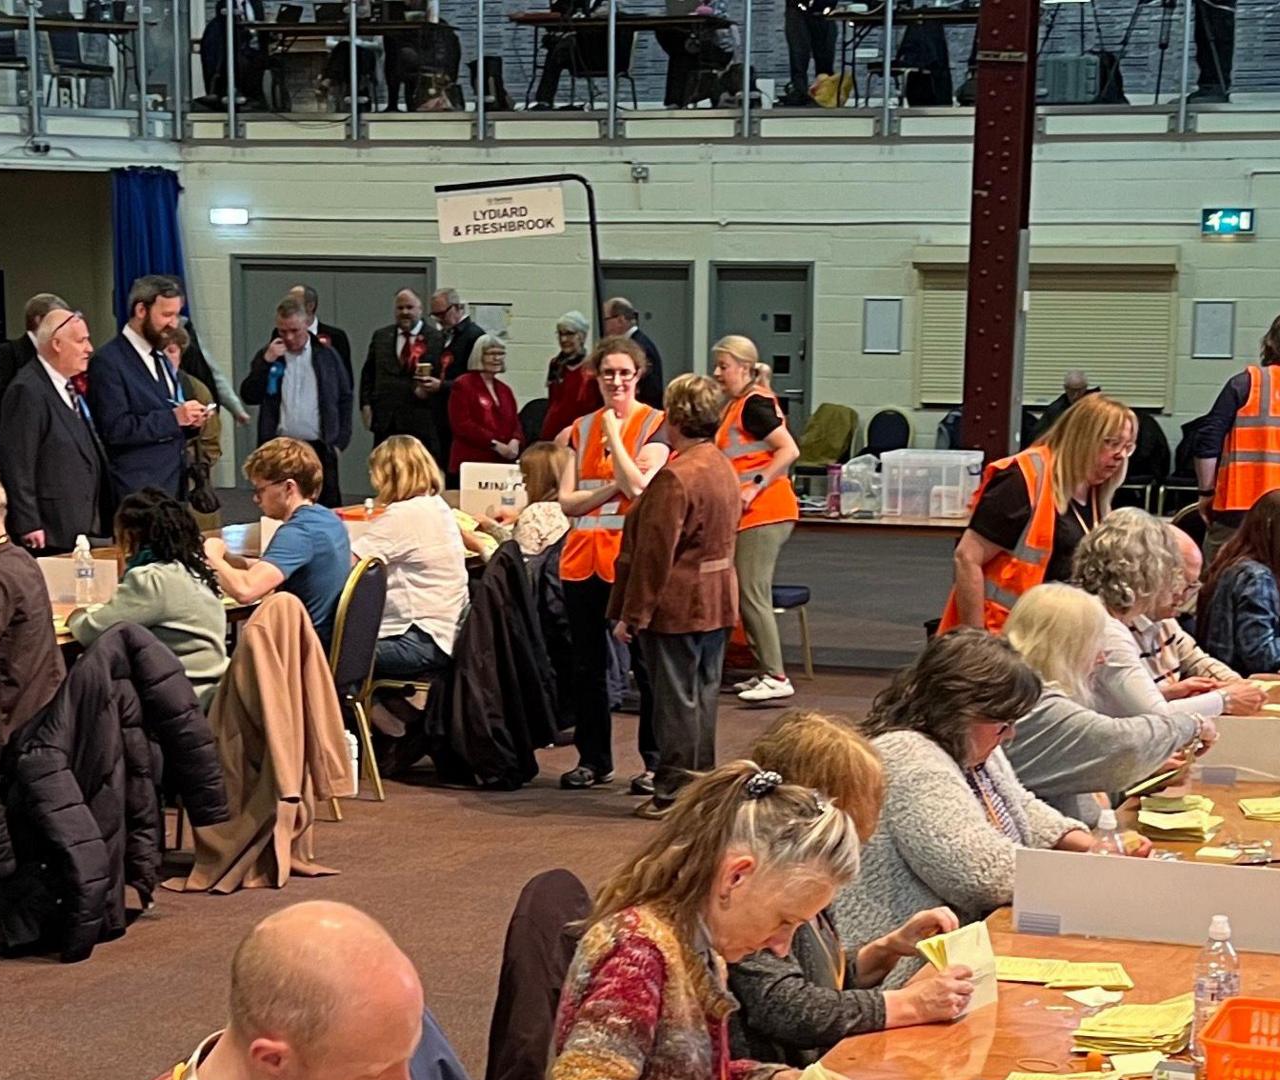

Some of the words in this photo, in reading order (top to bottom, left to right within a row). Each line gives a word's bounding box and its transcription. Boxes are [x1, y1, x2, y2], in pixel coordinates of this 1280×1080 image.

[473, 206, 528, 221] LYDIARD
[453, 226, 462, 237] &
[465, 217, 555, 236] FRESHBROOK
